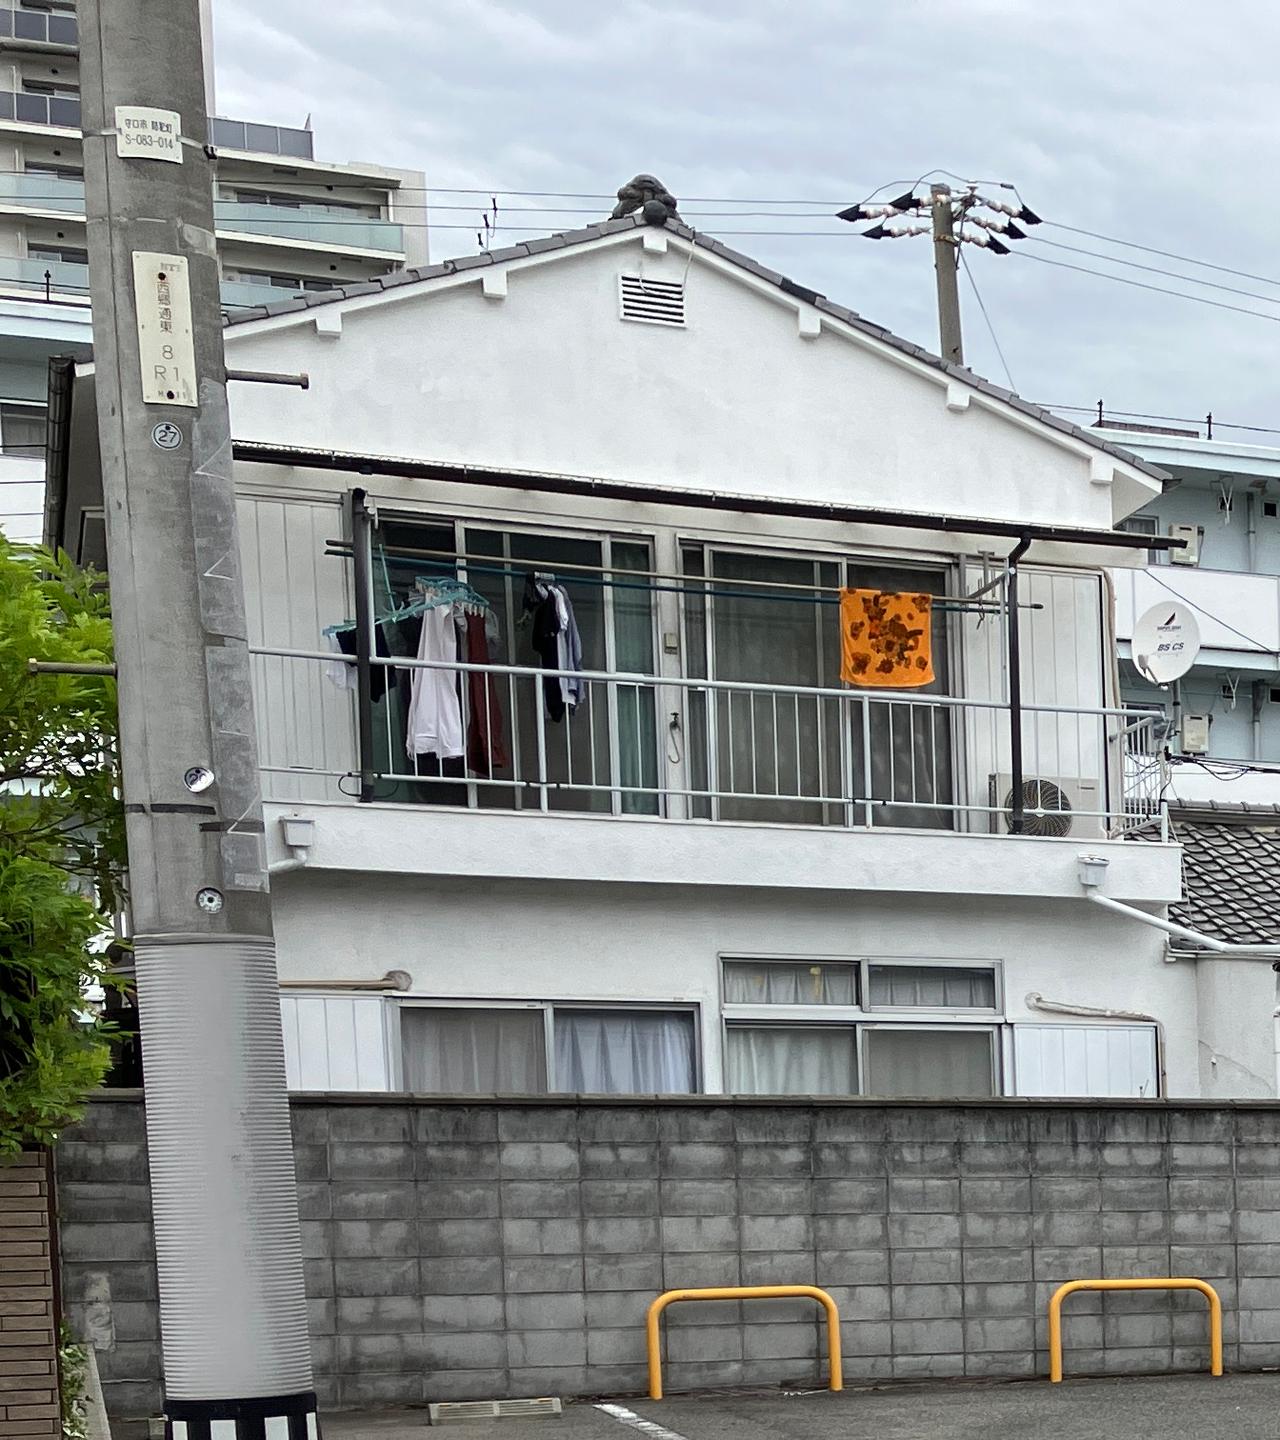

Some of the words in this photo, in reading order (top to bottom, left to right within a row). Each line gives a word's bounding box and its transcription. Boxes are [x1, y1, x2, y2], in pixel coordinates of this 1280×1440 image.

[162, 345, 174, 360] 8
[158, 429, 178, 443] 27
[1157, 643, 1170, 651] BS
[1172, 642, 1184, 651] CS
